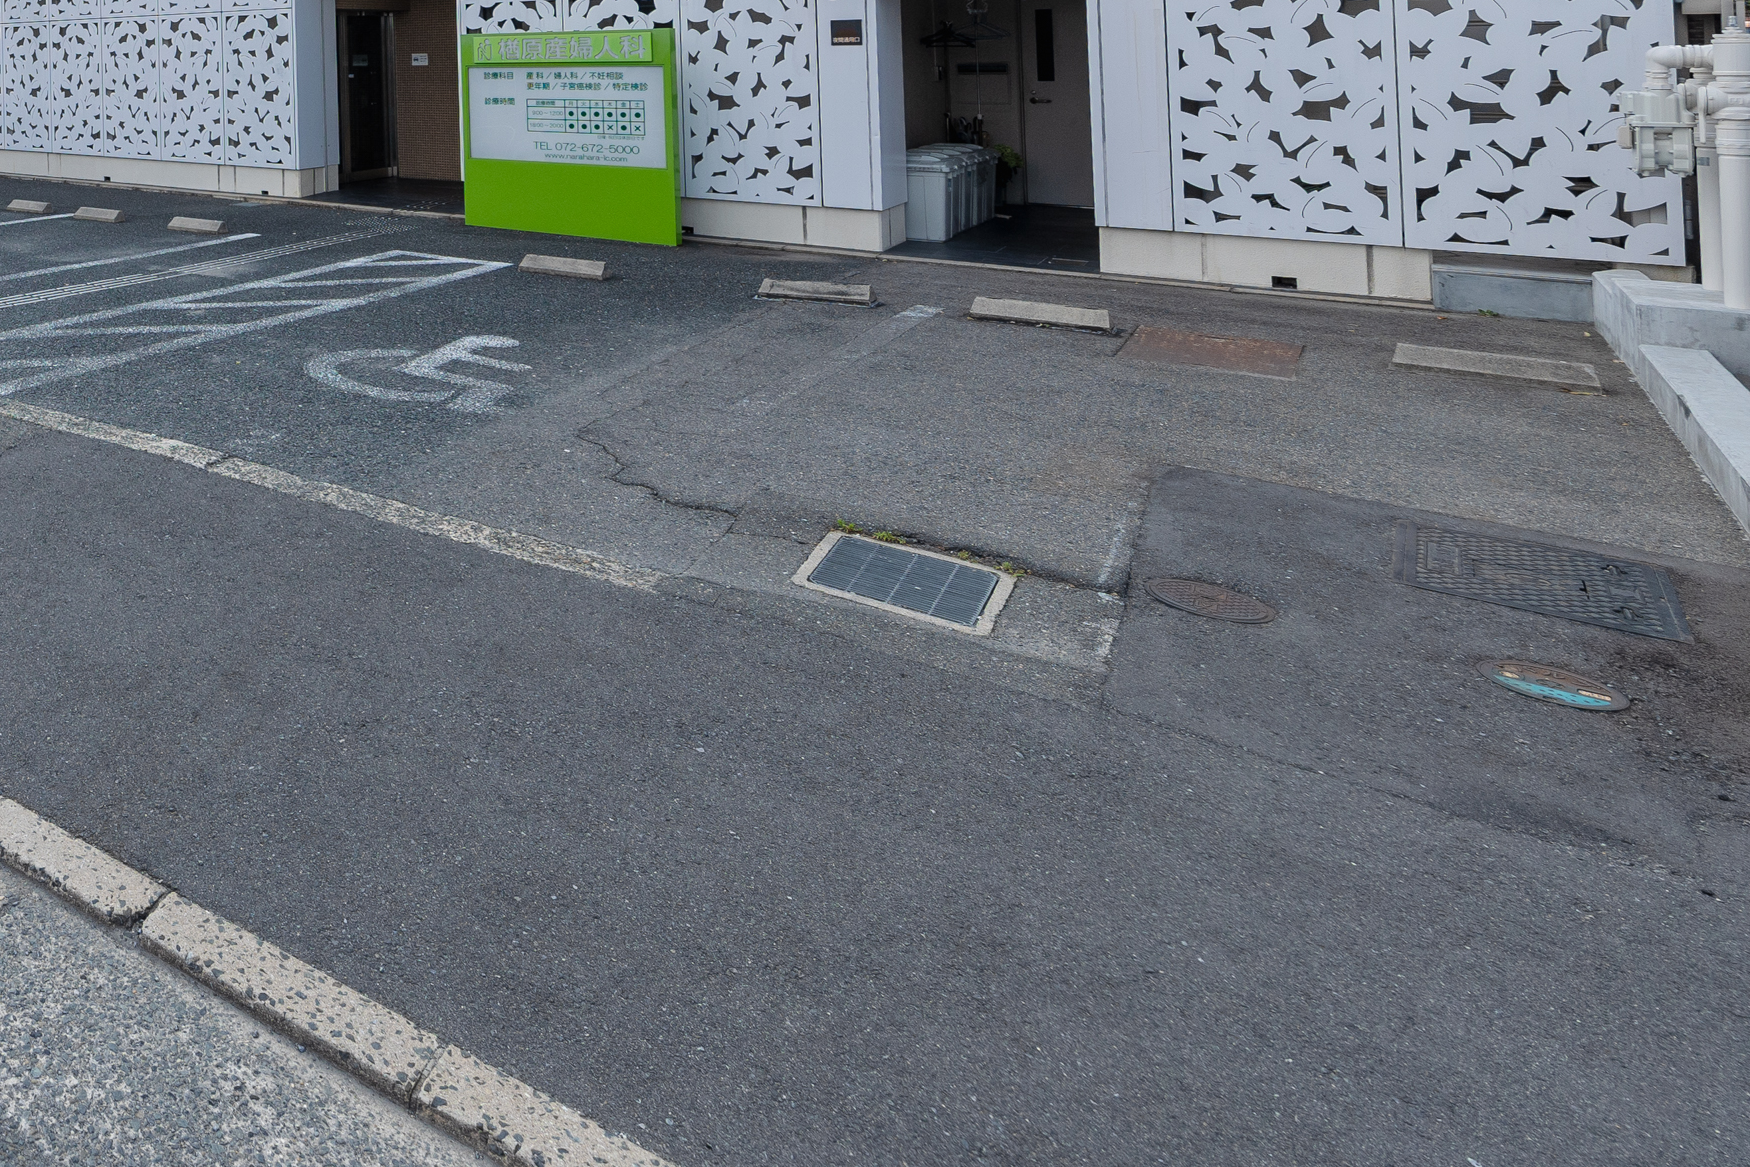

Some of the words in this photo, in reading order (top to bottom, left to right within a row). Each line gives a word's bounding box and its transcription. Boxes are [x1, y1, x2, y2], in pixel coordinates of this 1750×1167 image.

[498, 34, 647, 61] 楢原産婦人科
[483, 71, 514, 80] 診療科目
[484, 97, 516, 106] 診療時間
[533, 141, 553, 151] TEL
[555, 142, 640, 155] 072-672-5000
